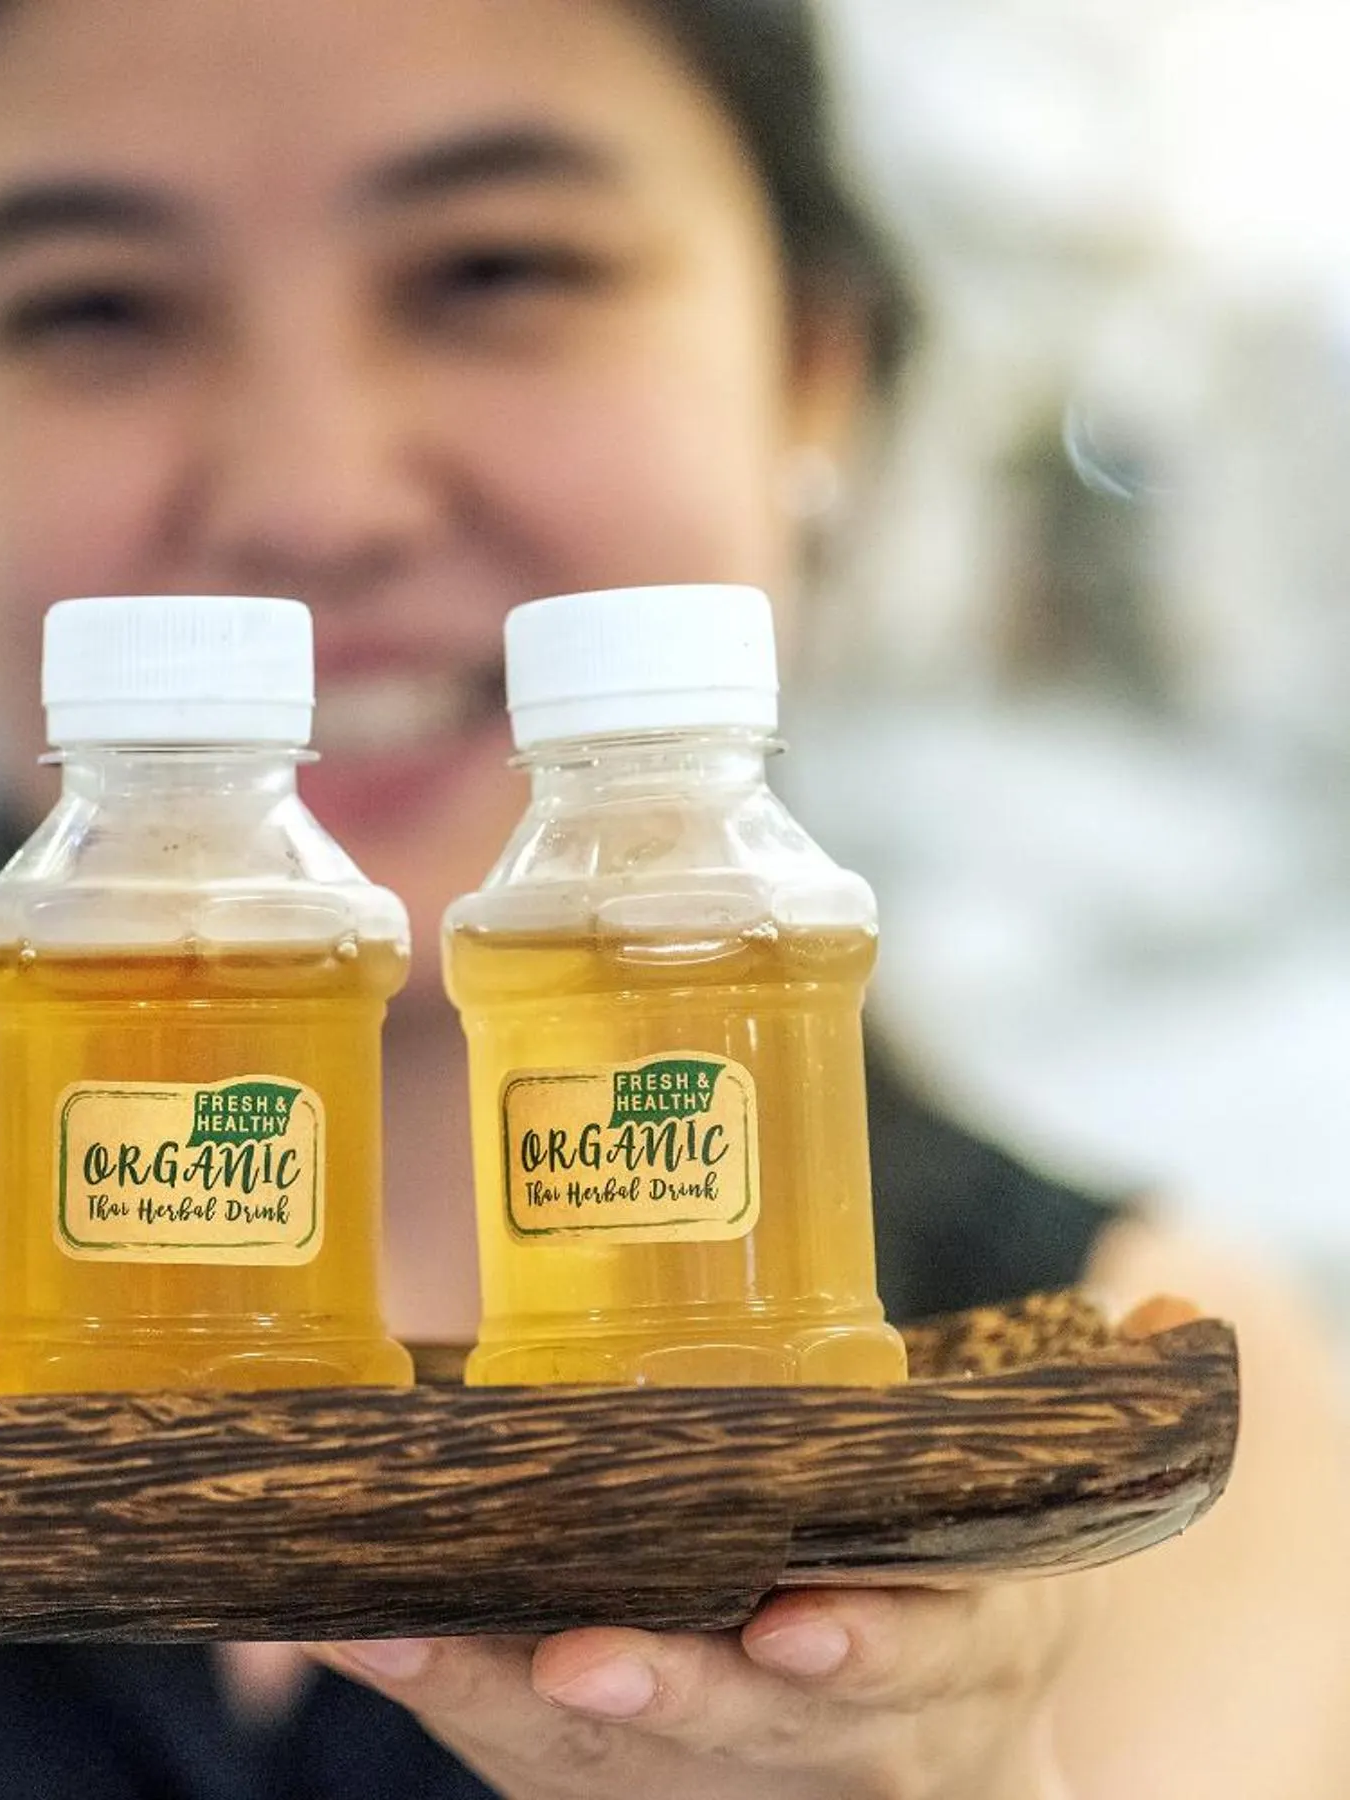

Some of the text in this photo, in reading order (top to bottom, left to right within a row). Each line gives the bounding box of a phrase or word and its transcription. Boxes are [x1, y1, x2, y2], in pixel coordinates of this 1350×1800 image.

[616, 1072, 710, 1092] FRESH &
[198, 1094, 288, 1113] FRESH &
[616, 1092, 711, 1112] HEALTHY
[197, 1114, 288, 1134] HEALTHY
[521, 1120, 729, 1173] ORGANIC
[83, 1140, 301, 1194] ORGANIC
[525, 1171, 720, 1208] Thai Herbal Drink
[86, 1194, 291, 1224] Thai Herbal Drink
